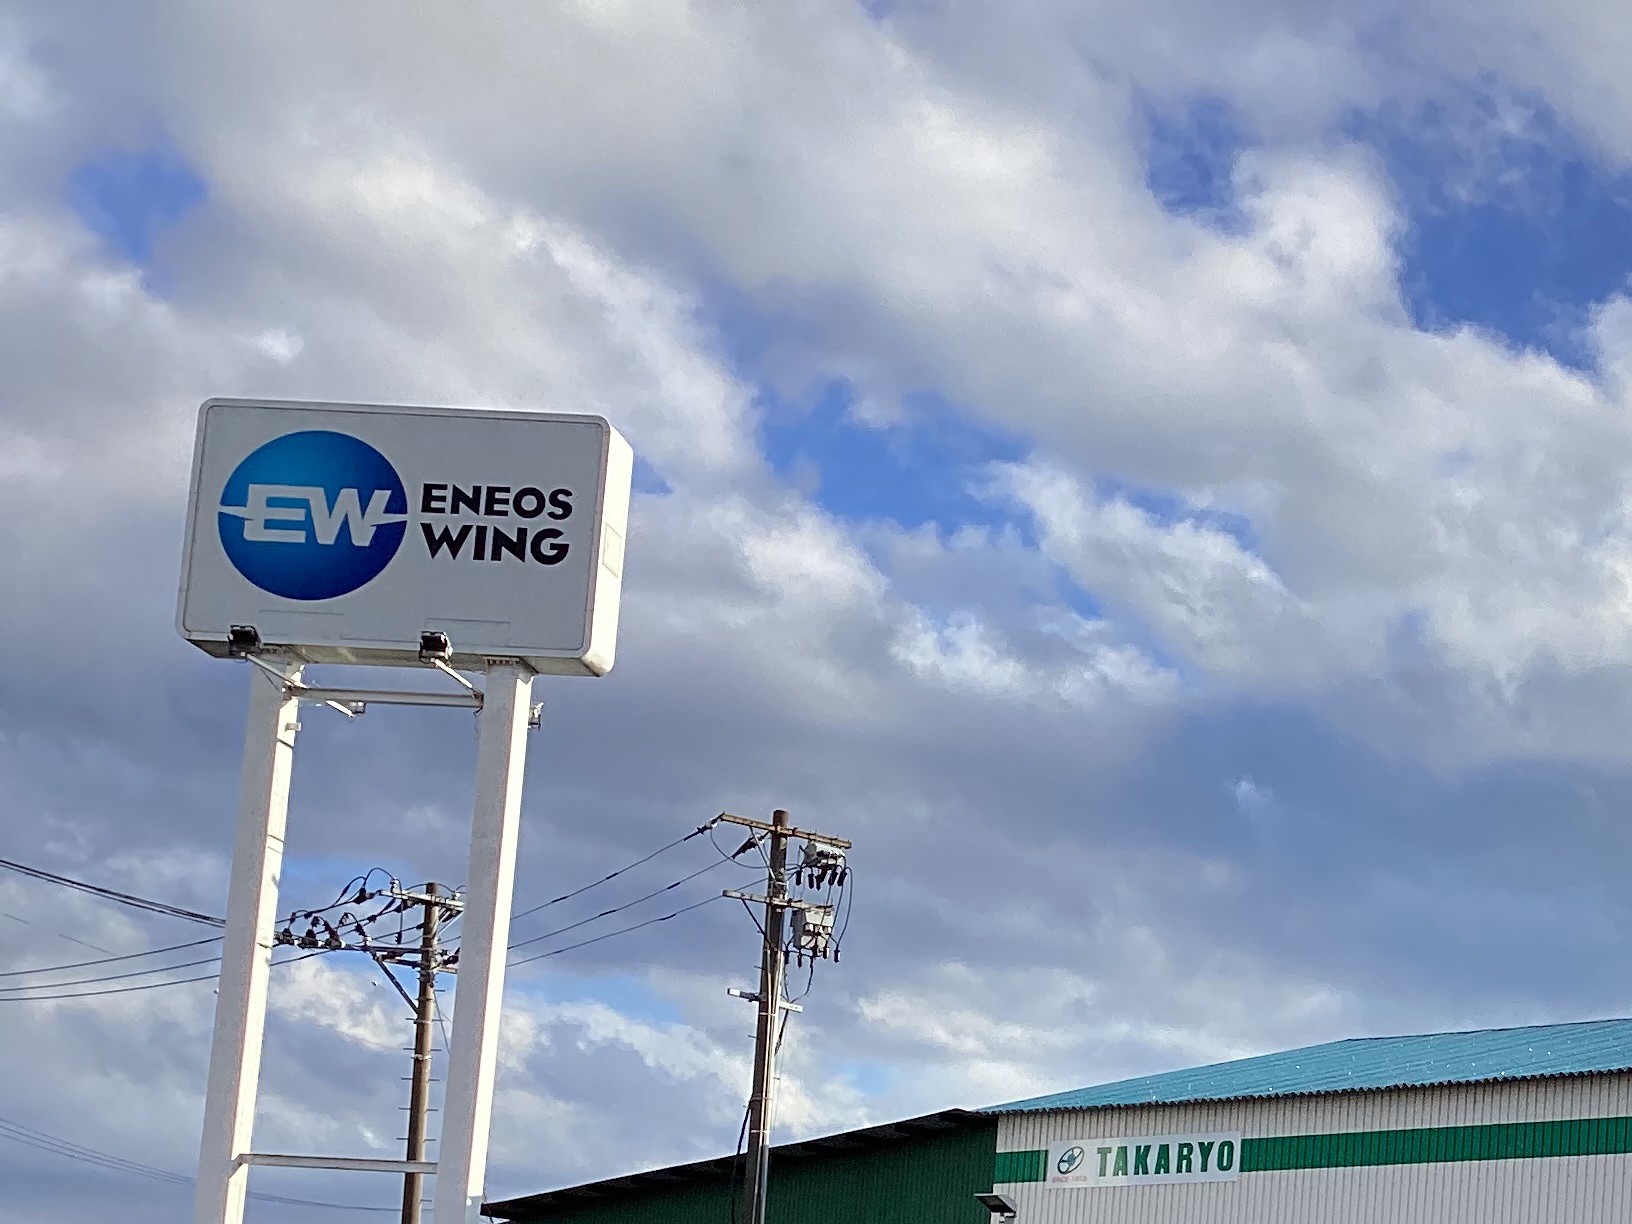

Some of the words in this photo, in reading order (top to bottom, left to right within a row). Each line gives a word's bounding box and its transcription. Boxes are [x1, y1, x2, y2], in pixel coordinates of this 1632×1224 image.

[420, 482, 574, 521] ENEOS
[420, 522, 571, 565] WING
[1097, 1140, 1235, 1178] TAKARYO
